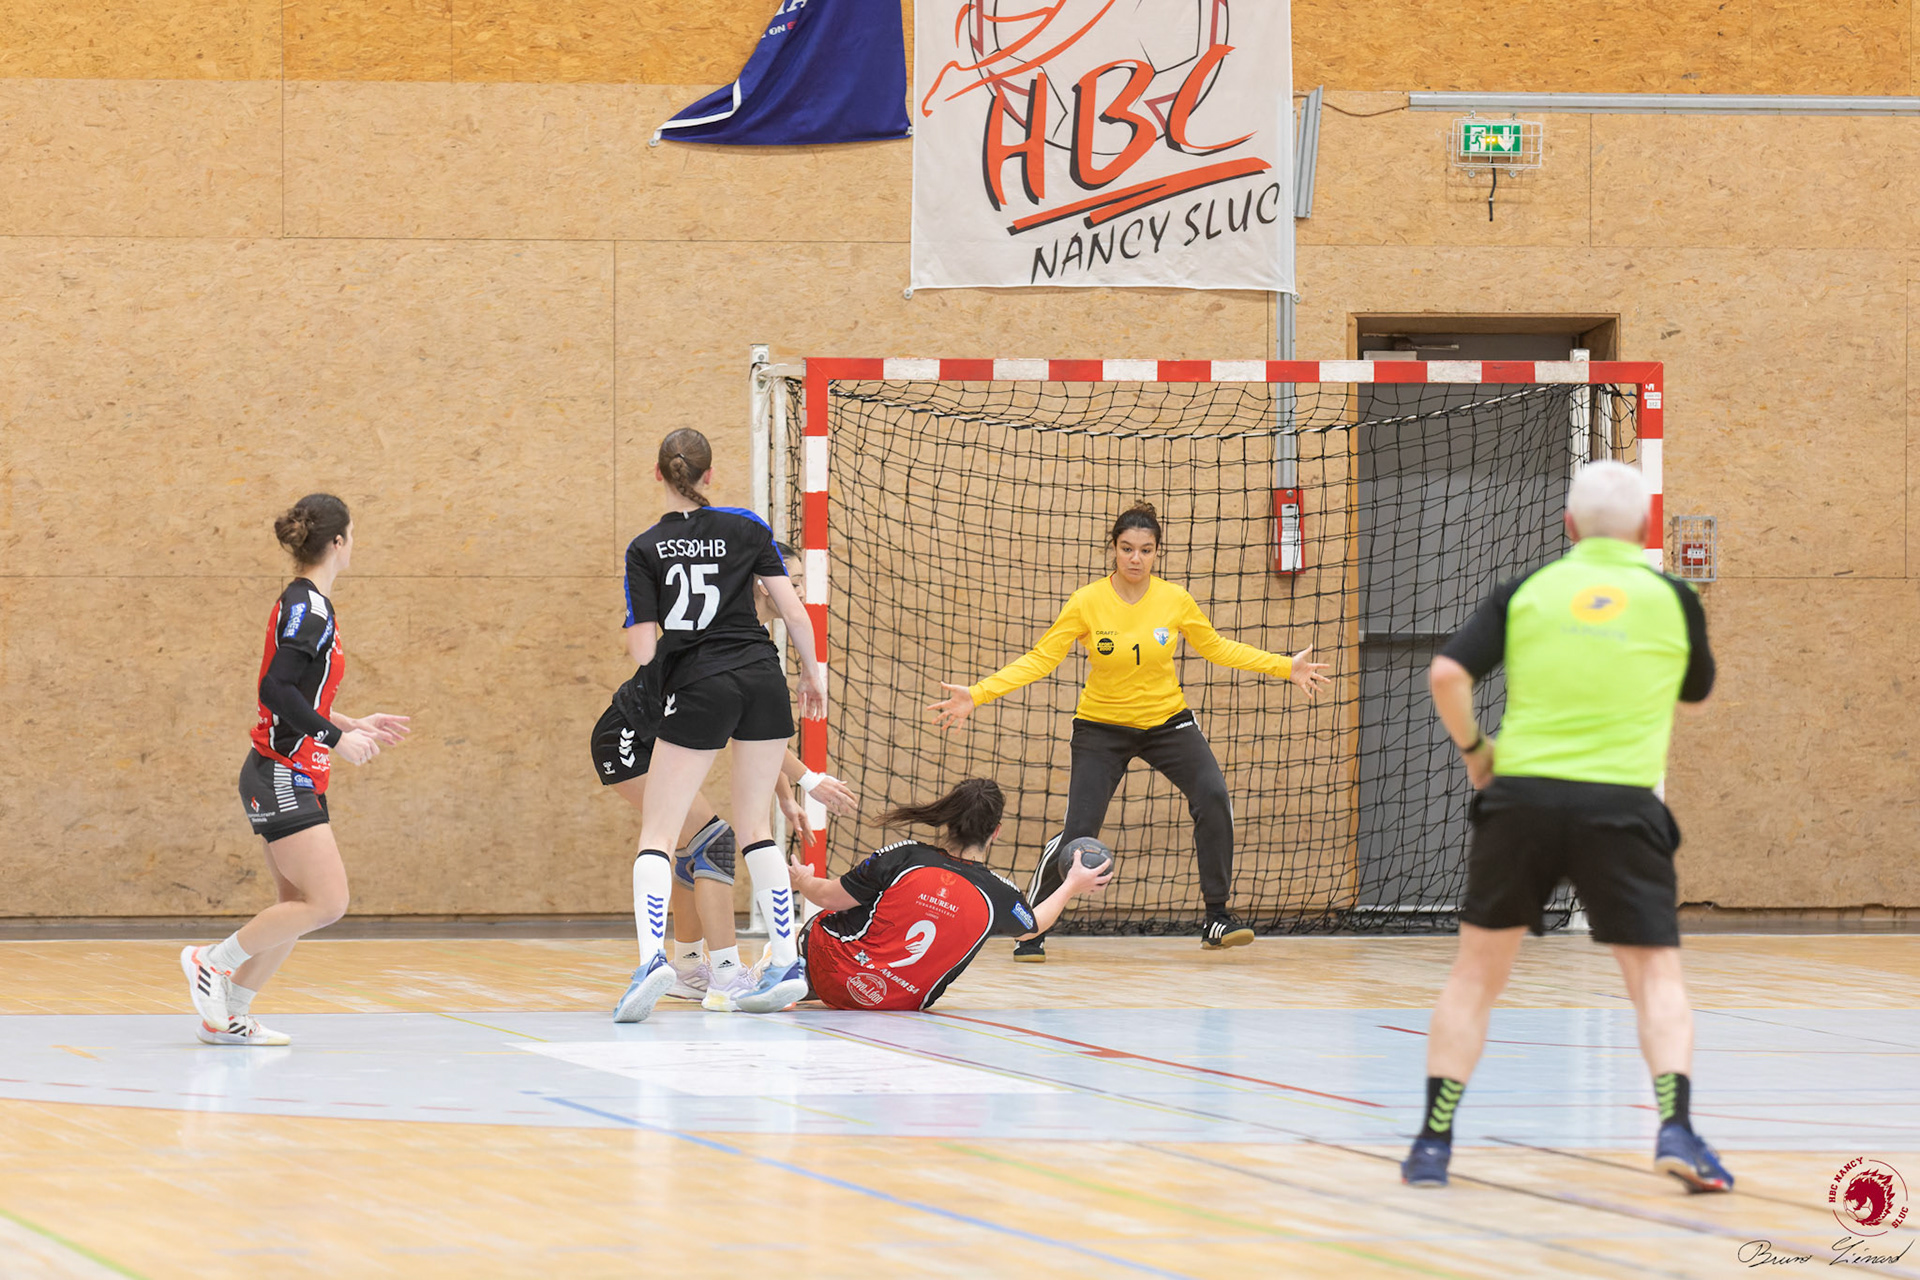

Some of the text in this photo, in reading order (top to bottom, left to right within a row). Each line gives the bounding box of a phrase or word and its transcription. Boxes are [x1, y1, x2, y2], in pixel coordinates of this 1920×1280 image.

[982, 44, 1259, 211] HBC
[1031, 182, 1280, 284] NANCY SLUC
[664, 563, 720, 631] 25
[1131, 643, 1141, 666] 1
[929, 896, 960, 913] BUREAU
[887, 919, 937, 968] 9
